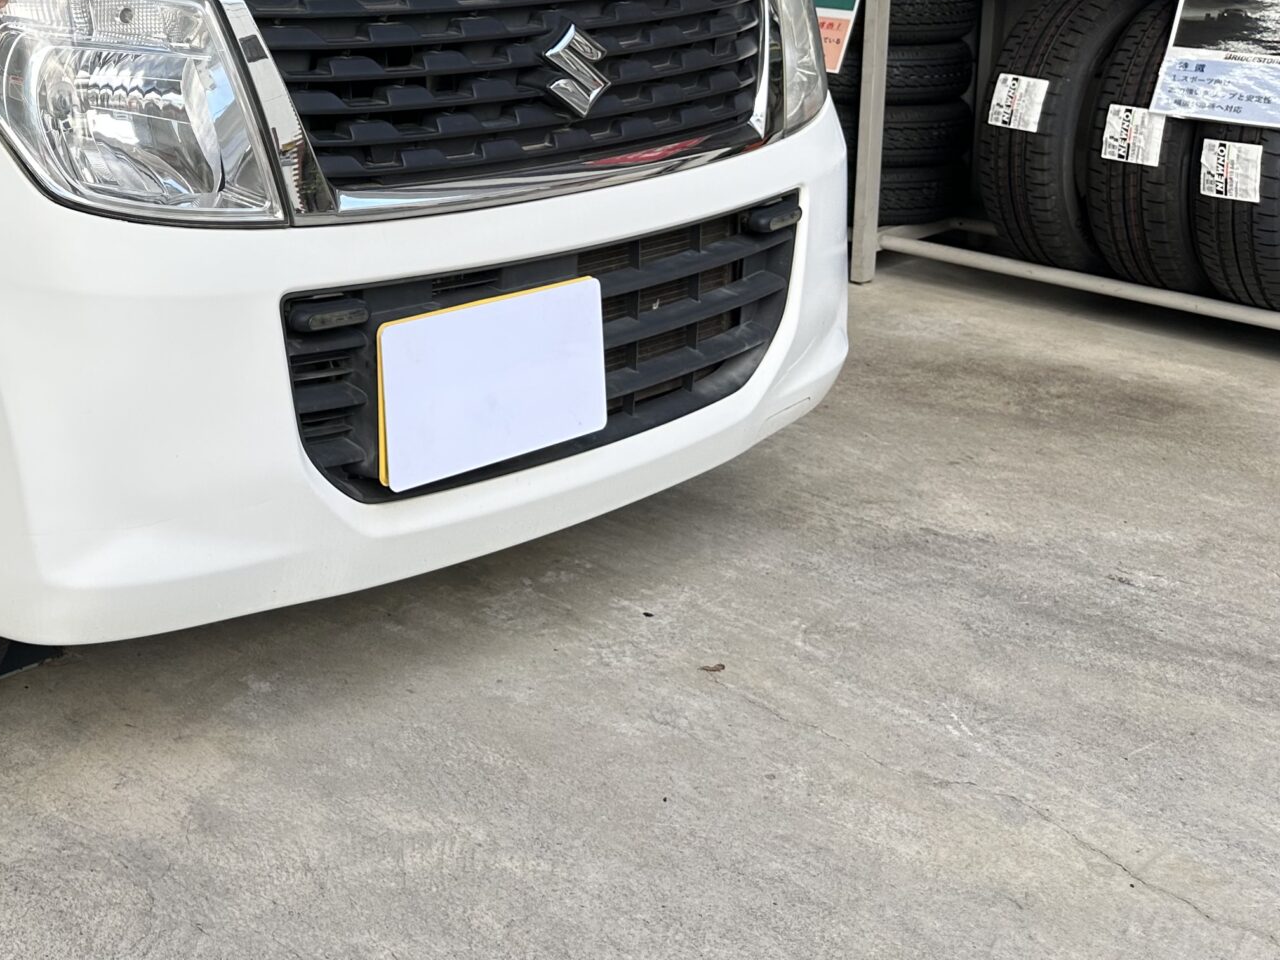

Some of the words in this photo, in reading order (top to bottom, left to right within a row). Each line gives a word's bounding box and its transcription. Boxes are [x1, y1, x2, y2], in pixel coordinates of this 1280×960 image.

[1001, 80, 1018, 121] NEWNO
[1117, 111, 1133, 158] NEWNO
[1215, 145, 1227, 191] NEWNO
